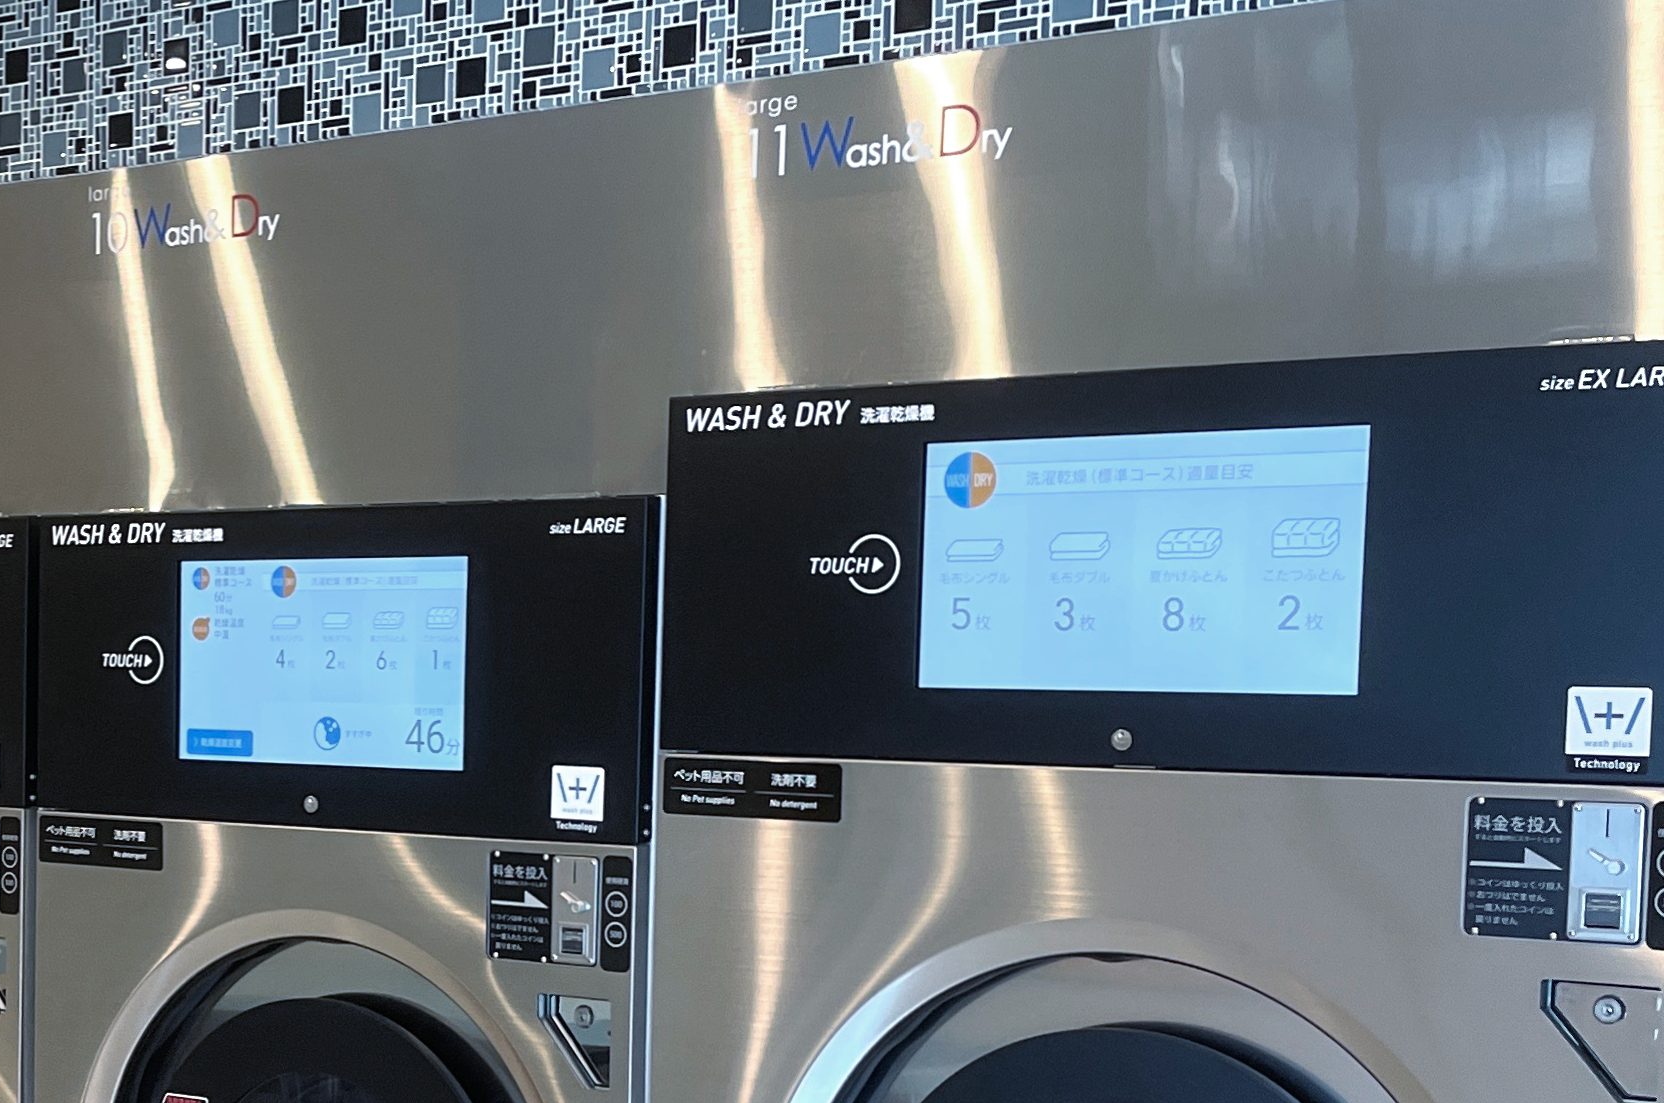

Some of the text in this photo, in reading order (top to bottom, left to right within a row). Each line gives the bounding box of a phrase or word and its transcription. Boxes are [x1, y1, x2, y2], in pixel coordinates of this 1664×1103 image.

[741, 94, 798, 117] arge
[749, 124, 786, 179] 11
[91, 212, 129, 255] 10
[1539, 373, 1575, 391] size
[1577, 368, 1611, 390] EX
[686, 399, 936, 433] WASH & DRY 洗濯乾燥機
[973, 472, 994, 488] DRY
[52, 524, 105, 546] WASH
[108, 523, 123, 545] &
[127, 522, 166, 545] DRY
[549, 516, 627, 534] size LARGE
[809, 557, 870, 575] TOUCH
[939, 571, 1011, 585] 毛布シングル
[1049, 570, 1110, 585] 毛布ダブル
[1262, 569, 1346, 583] こたつふとん
[102, 652, 143, 669] TOUCH
[1584, 740, 1633, 749] wash plus
[1573, 757, 1641, 773] Technology
[673, 768, 817, 789] ペット用品不可 洗剤不要
[555, 820, 597, 833] Technology
[1473, 814, 1563, 834] 料金を投入
[492, 863, 549, 881] 料金を投入
